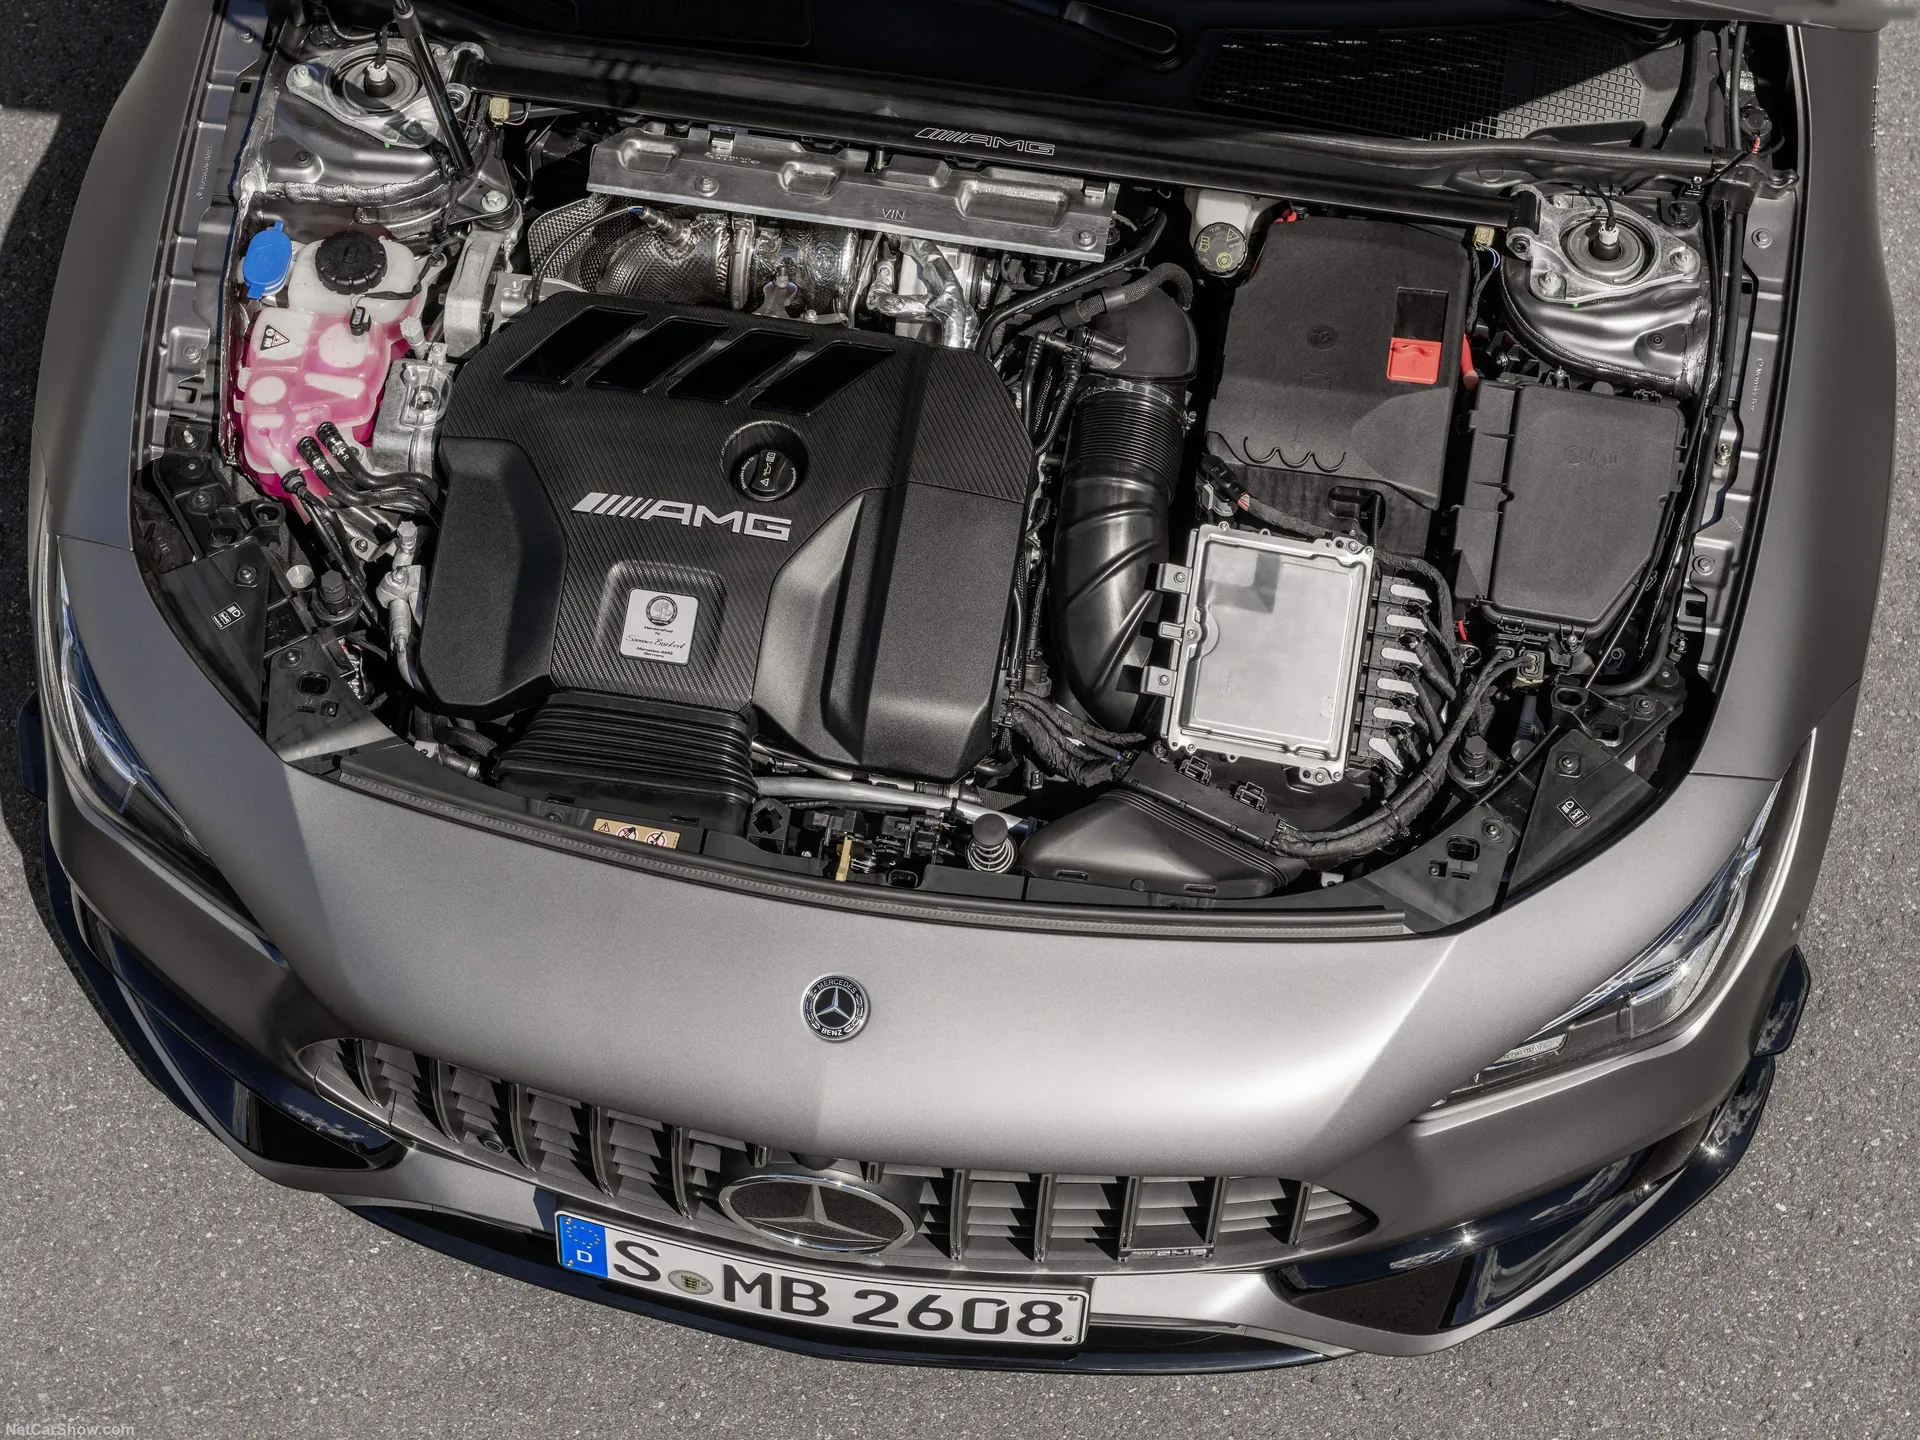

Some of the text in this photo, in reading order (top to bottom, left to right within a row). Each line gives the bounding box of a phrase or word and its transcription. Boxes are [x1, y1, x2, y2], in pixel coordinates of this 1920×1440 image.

[959, 132, 1056, 156] AMG
[882, 208, 906, 220] VIN
[640, 499, 792, 541] AMG
[817, 979, 857, 994] MERCEDES
[821, 1028, 843, 1036] BENZ
[576, 1249, 593, 1264] D
[613, 1239, 662, 1283] S
[723, 1263, 830, 1317] MB
[852, 1289, 1064, 1337] 2608
